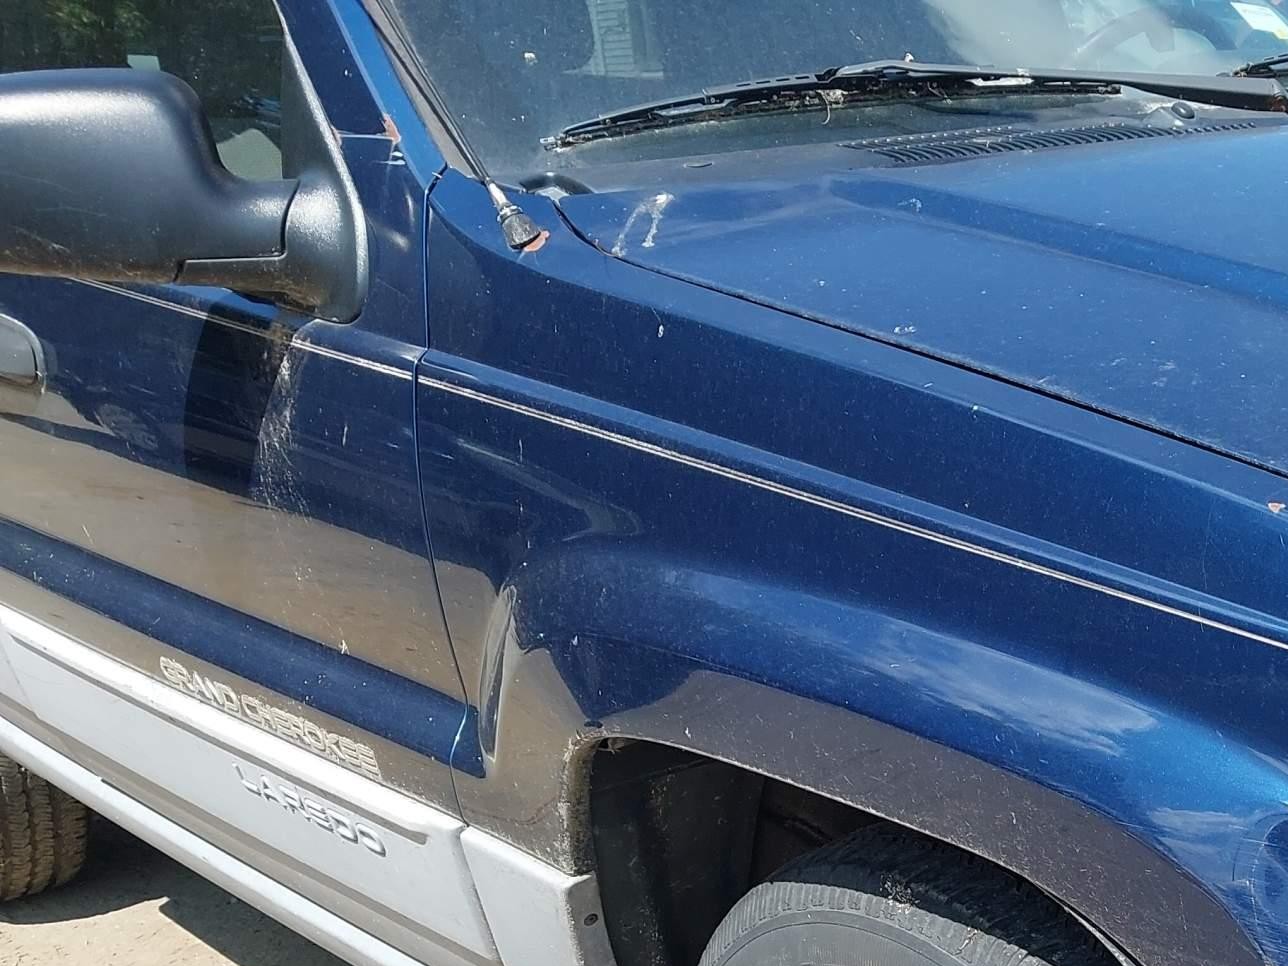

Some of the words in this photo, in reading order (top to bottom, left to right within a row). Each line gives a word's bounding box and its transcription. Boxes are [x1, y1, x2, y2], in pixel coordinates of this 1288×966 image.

[159, 655, 242, 716] GRAND
[240, 693, 382, 780] CHEROKEE
[231, 762, 387, 858] LAREDO
